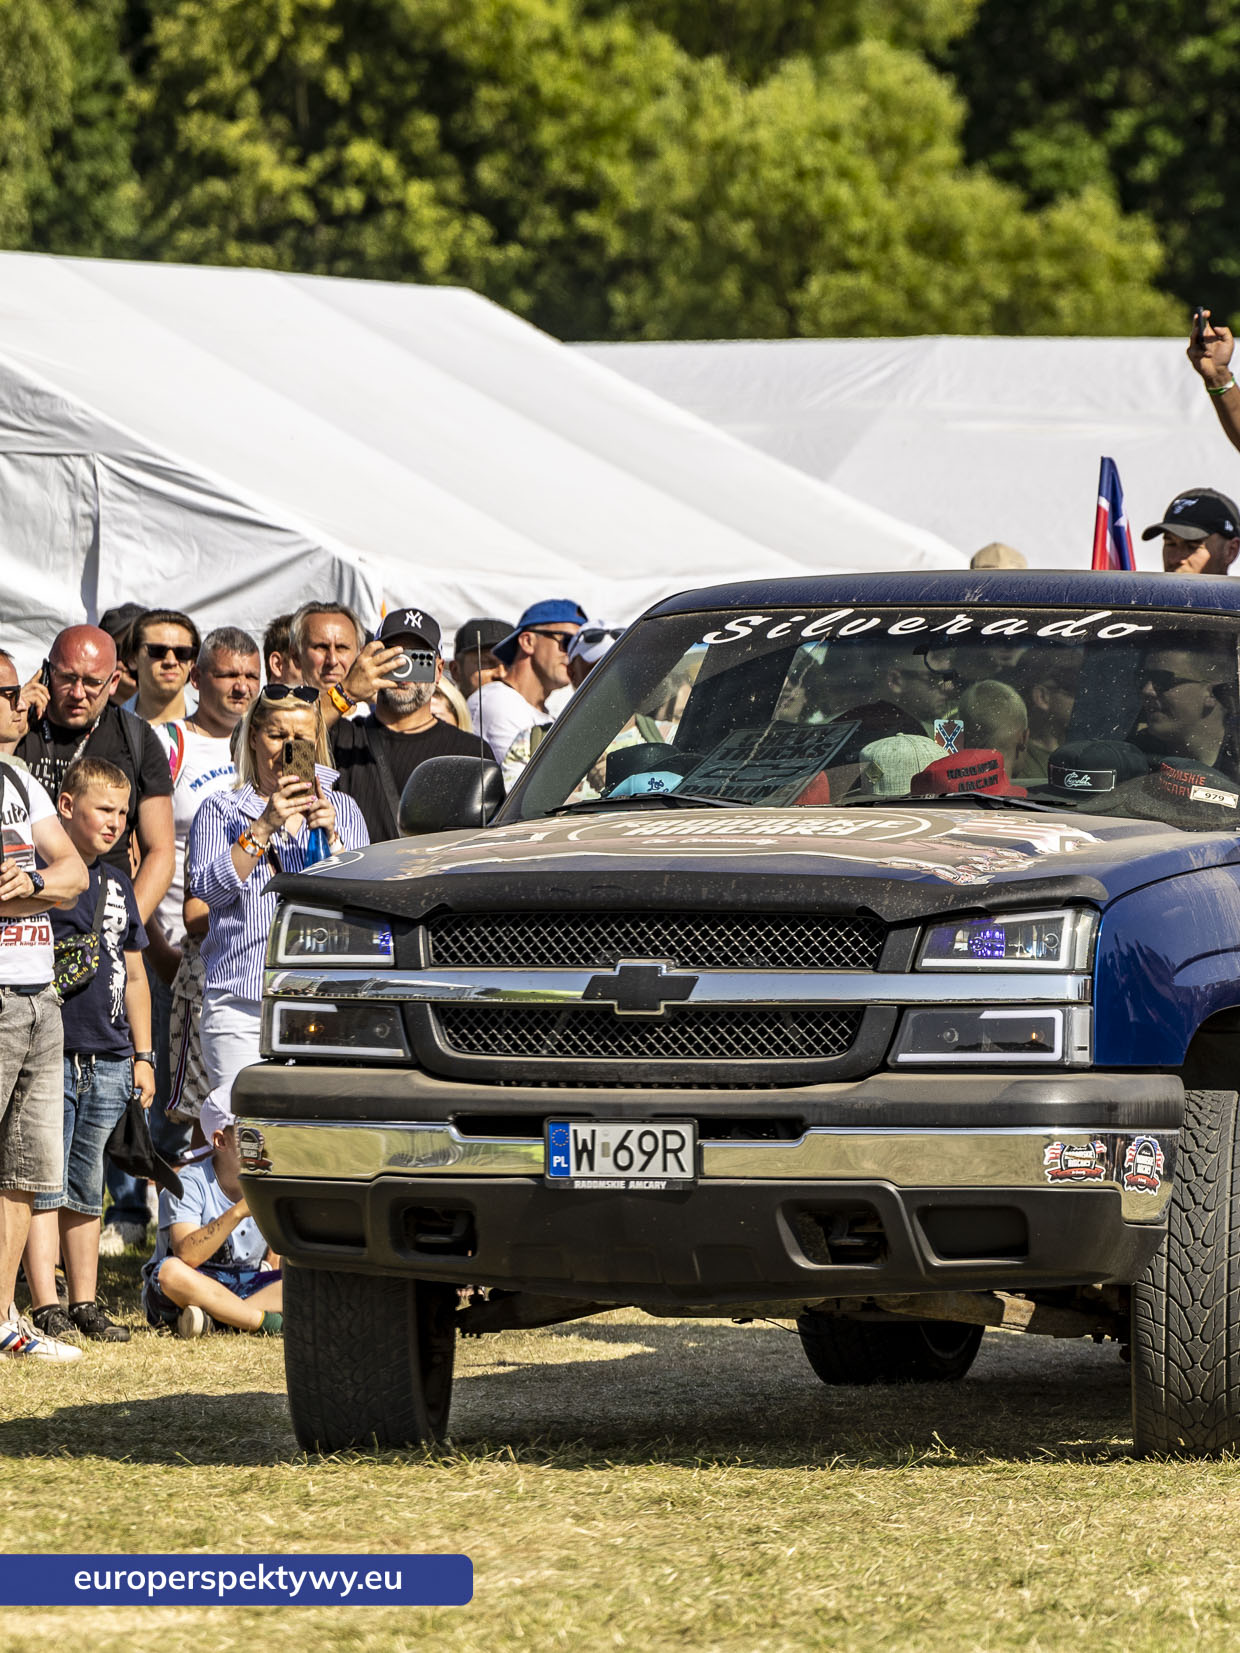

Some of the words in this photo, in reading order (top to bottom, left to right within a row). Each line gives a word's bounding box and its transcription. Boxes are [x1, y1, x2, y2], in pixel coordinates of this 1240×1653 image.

[404, 610, 423, 629] NY
[703, 608, 1153, 645] Silverado
[1205, 792, 1225, 802] 979
[608, 818, 914, 829] RADOMSKIE
[620, 826, 866, 836] AMCARY
[0, 925, 50, 942] 970
[573, 1129, 596, 1172] W
[613, 1129, 686, 1172] 69R
[553, 1156, 568, 1167] PL
[574, 1180, 626, 1189] RADOMSKIE
[628, 1180, 667, 1189] AMCARY
